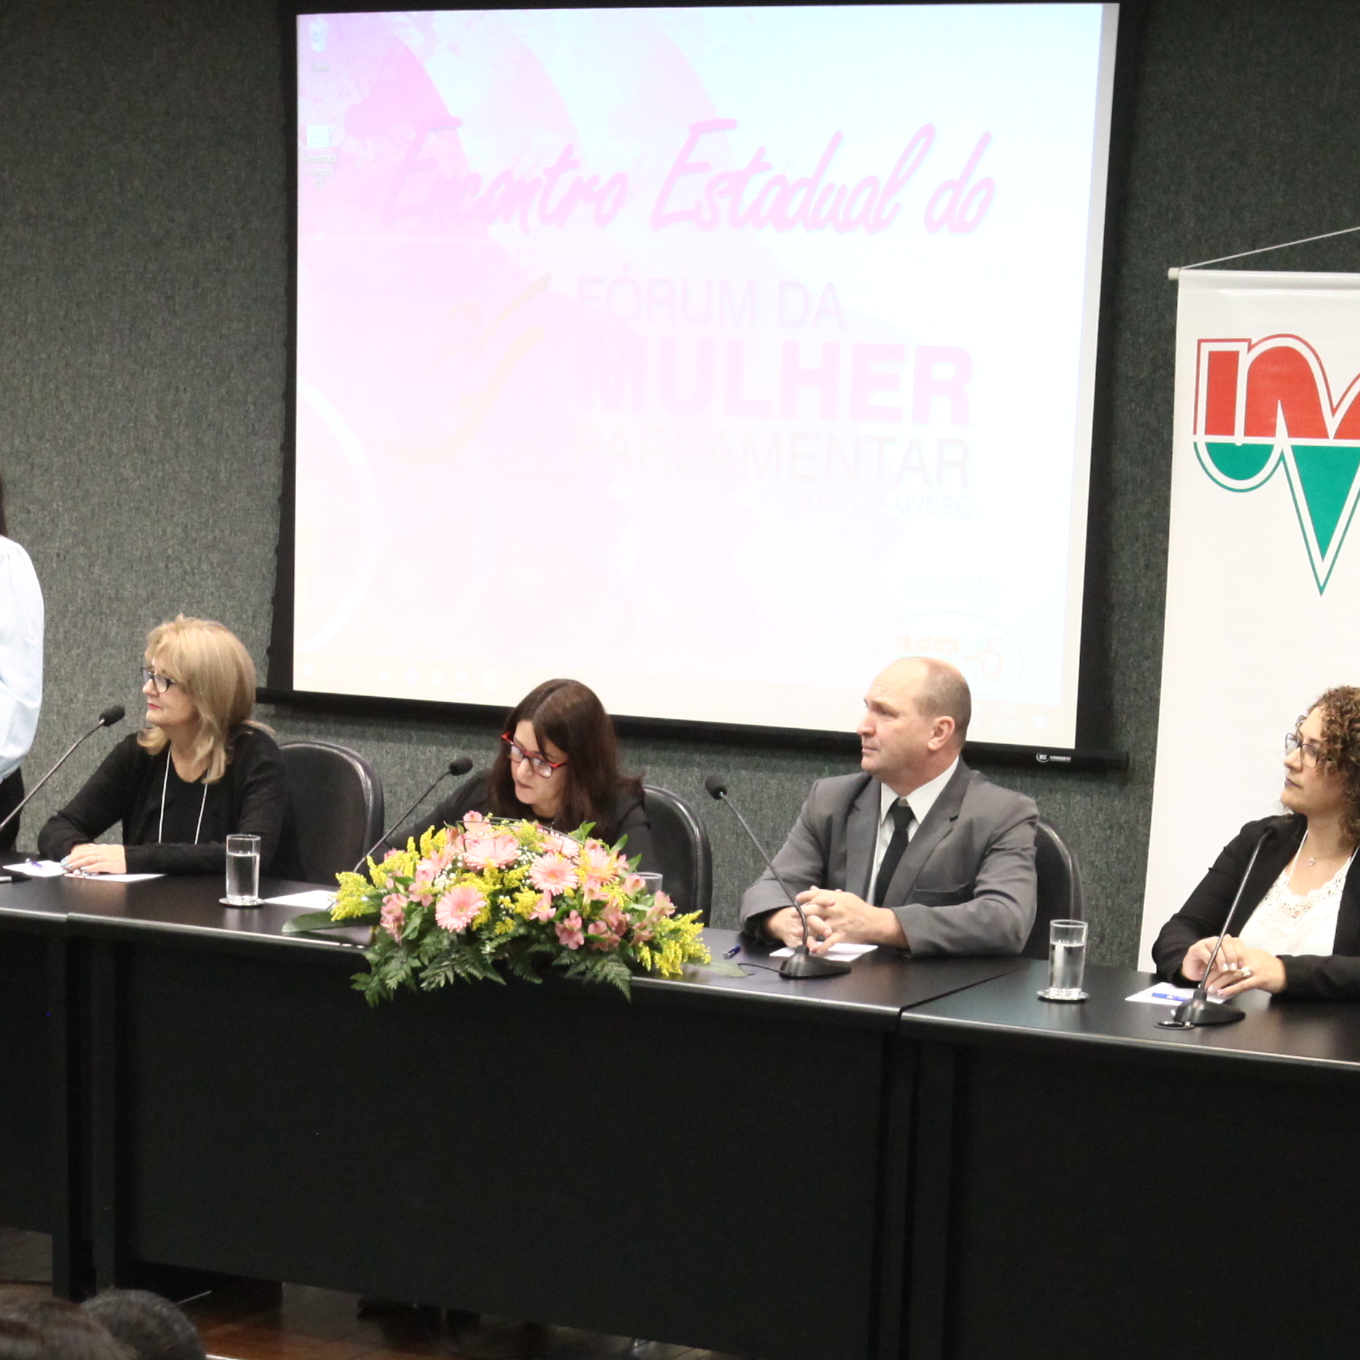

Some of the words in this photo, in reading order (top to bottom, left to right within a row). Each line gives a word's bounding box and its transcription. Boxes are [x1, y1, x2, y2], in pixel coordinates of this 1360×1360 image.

[382, 116, 630, 231] Encontro
[649, 118, 935, 234] Estadual
[928, 130, 997, 236] do
[575, 262, 758, 330] FÓRUM
[775, 280, 846, 330] DA
[574, 334, 975, 428] MULHER
[573, 422, 972, 490] PARLAMENTAR
